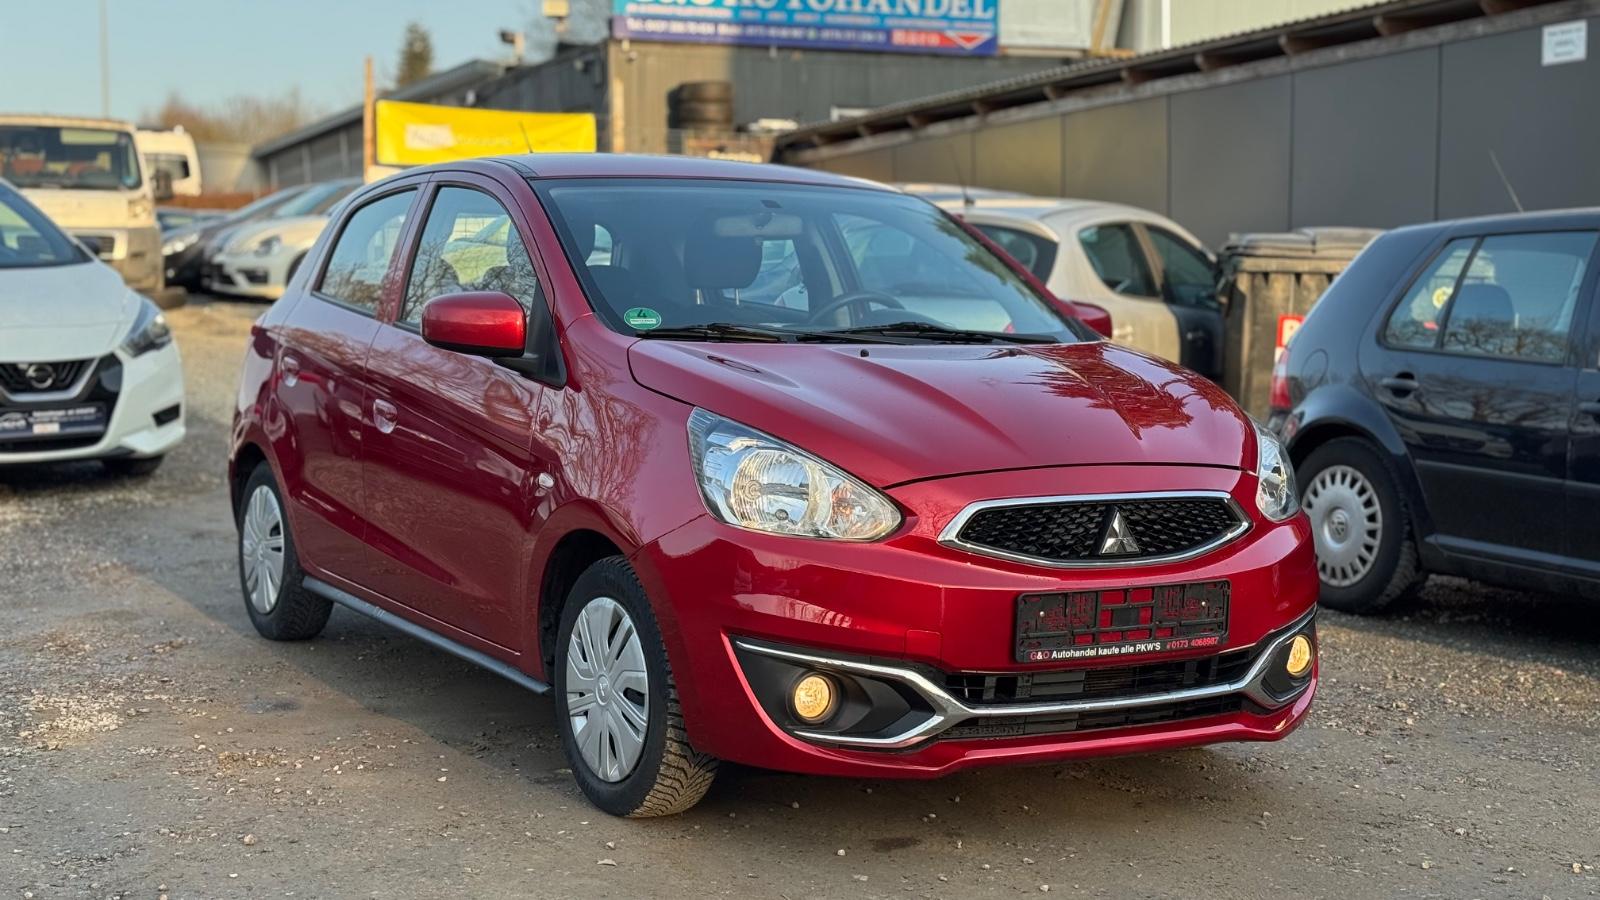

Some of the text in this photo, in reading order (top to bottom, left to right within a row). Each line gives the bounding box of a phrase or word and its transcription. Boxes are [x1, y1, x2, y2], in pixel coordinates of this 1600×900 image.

[1030, 651, 1050, 660] G&O
[1051, 648, 1096, 659] Autohandel
[1098, 646, 1119, 656] kaufe
[1120, 645, 1134, 653] alle
